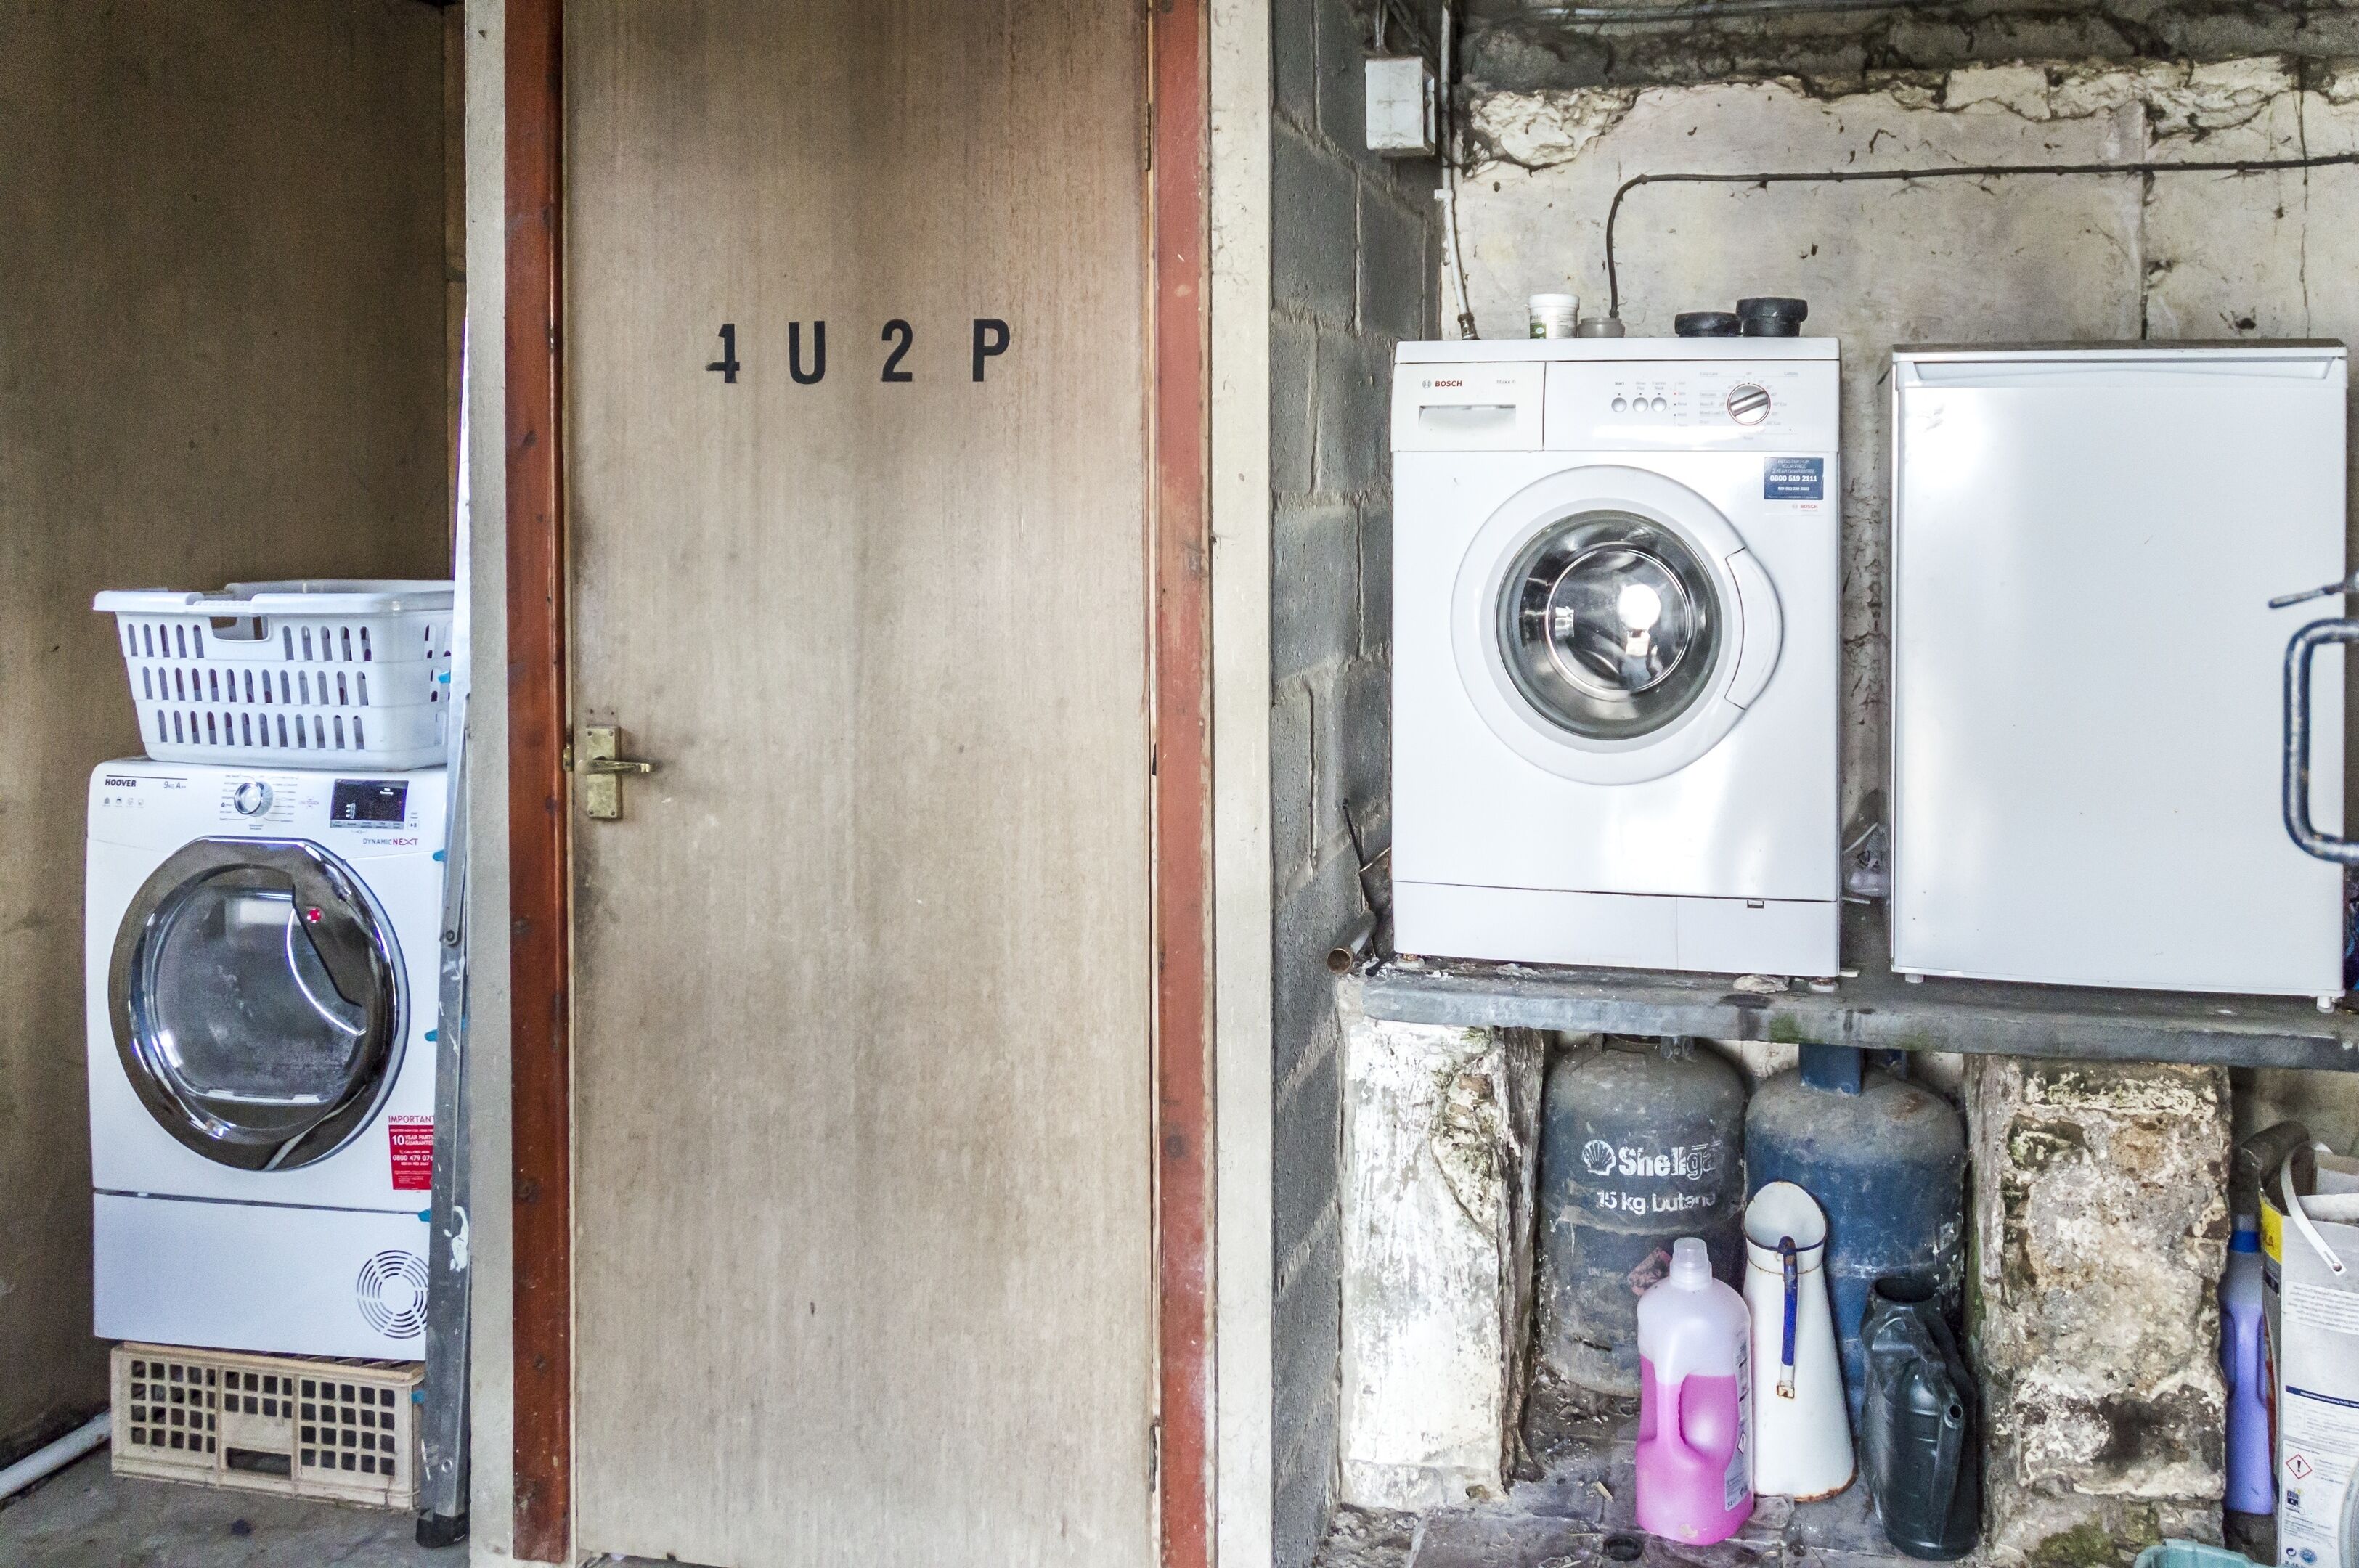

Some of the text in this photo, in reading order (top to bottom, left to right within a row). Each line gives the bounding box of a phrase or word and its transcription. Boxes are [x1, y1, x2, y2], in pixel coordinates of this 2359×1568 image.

[789, 320, 826, 384] U
[881, 318, 913, 383] 2
[972, 318, 1011, 382] P
[105, 778, 137, 787] HOOVER
[391, 1135, 405, 1146] 10
[1596, 1189, 1618, 1210] 15
[1621, 1191, 1646, 1216] kg
